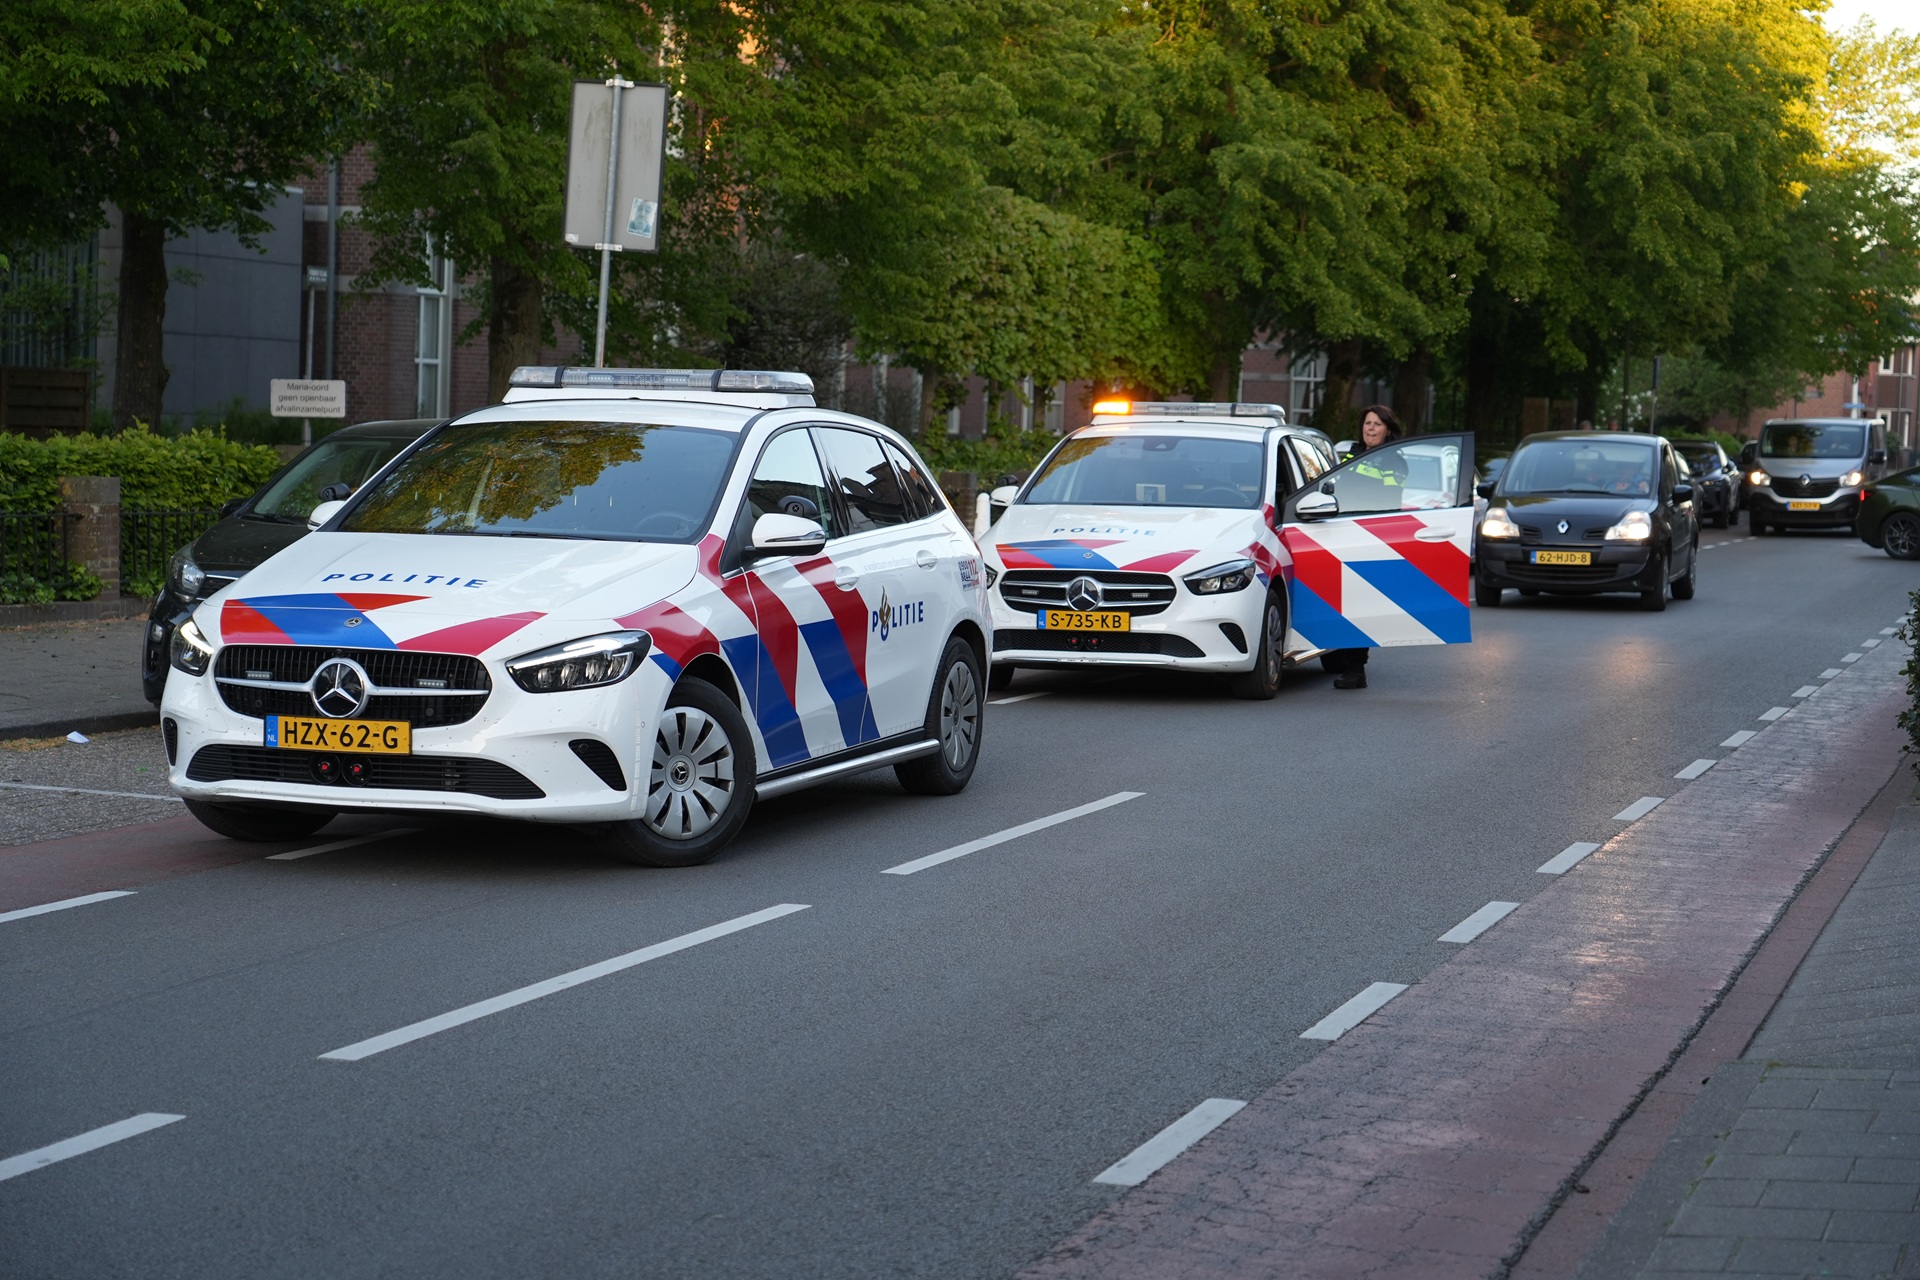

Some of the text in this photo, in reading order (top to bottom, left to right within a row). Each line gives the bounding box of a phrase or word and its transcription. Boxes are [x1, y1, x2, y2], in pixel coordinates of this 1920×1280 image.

[286, 383, 329, 391] Maria-oord
[300, 394, 337, 402] openbaar
[275, 404, 341, 414] afvalinzamelpunt
[1052, 527, 1157, 537] POLITIE
[1539, 552, 1588, 563] 62-HJD-8
[321, 573, 488, 589] POLITIE
[872, 600, 924, 641] POLITIE
[1050, 612, 1122, 628] S-735-KB
[267, 720, 398, 749] NL HZX-62-G
